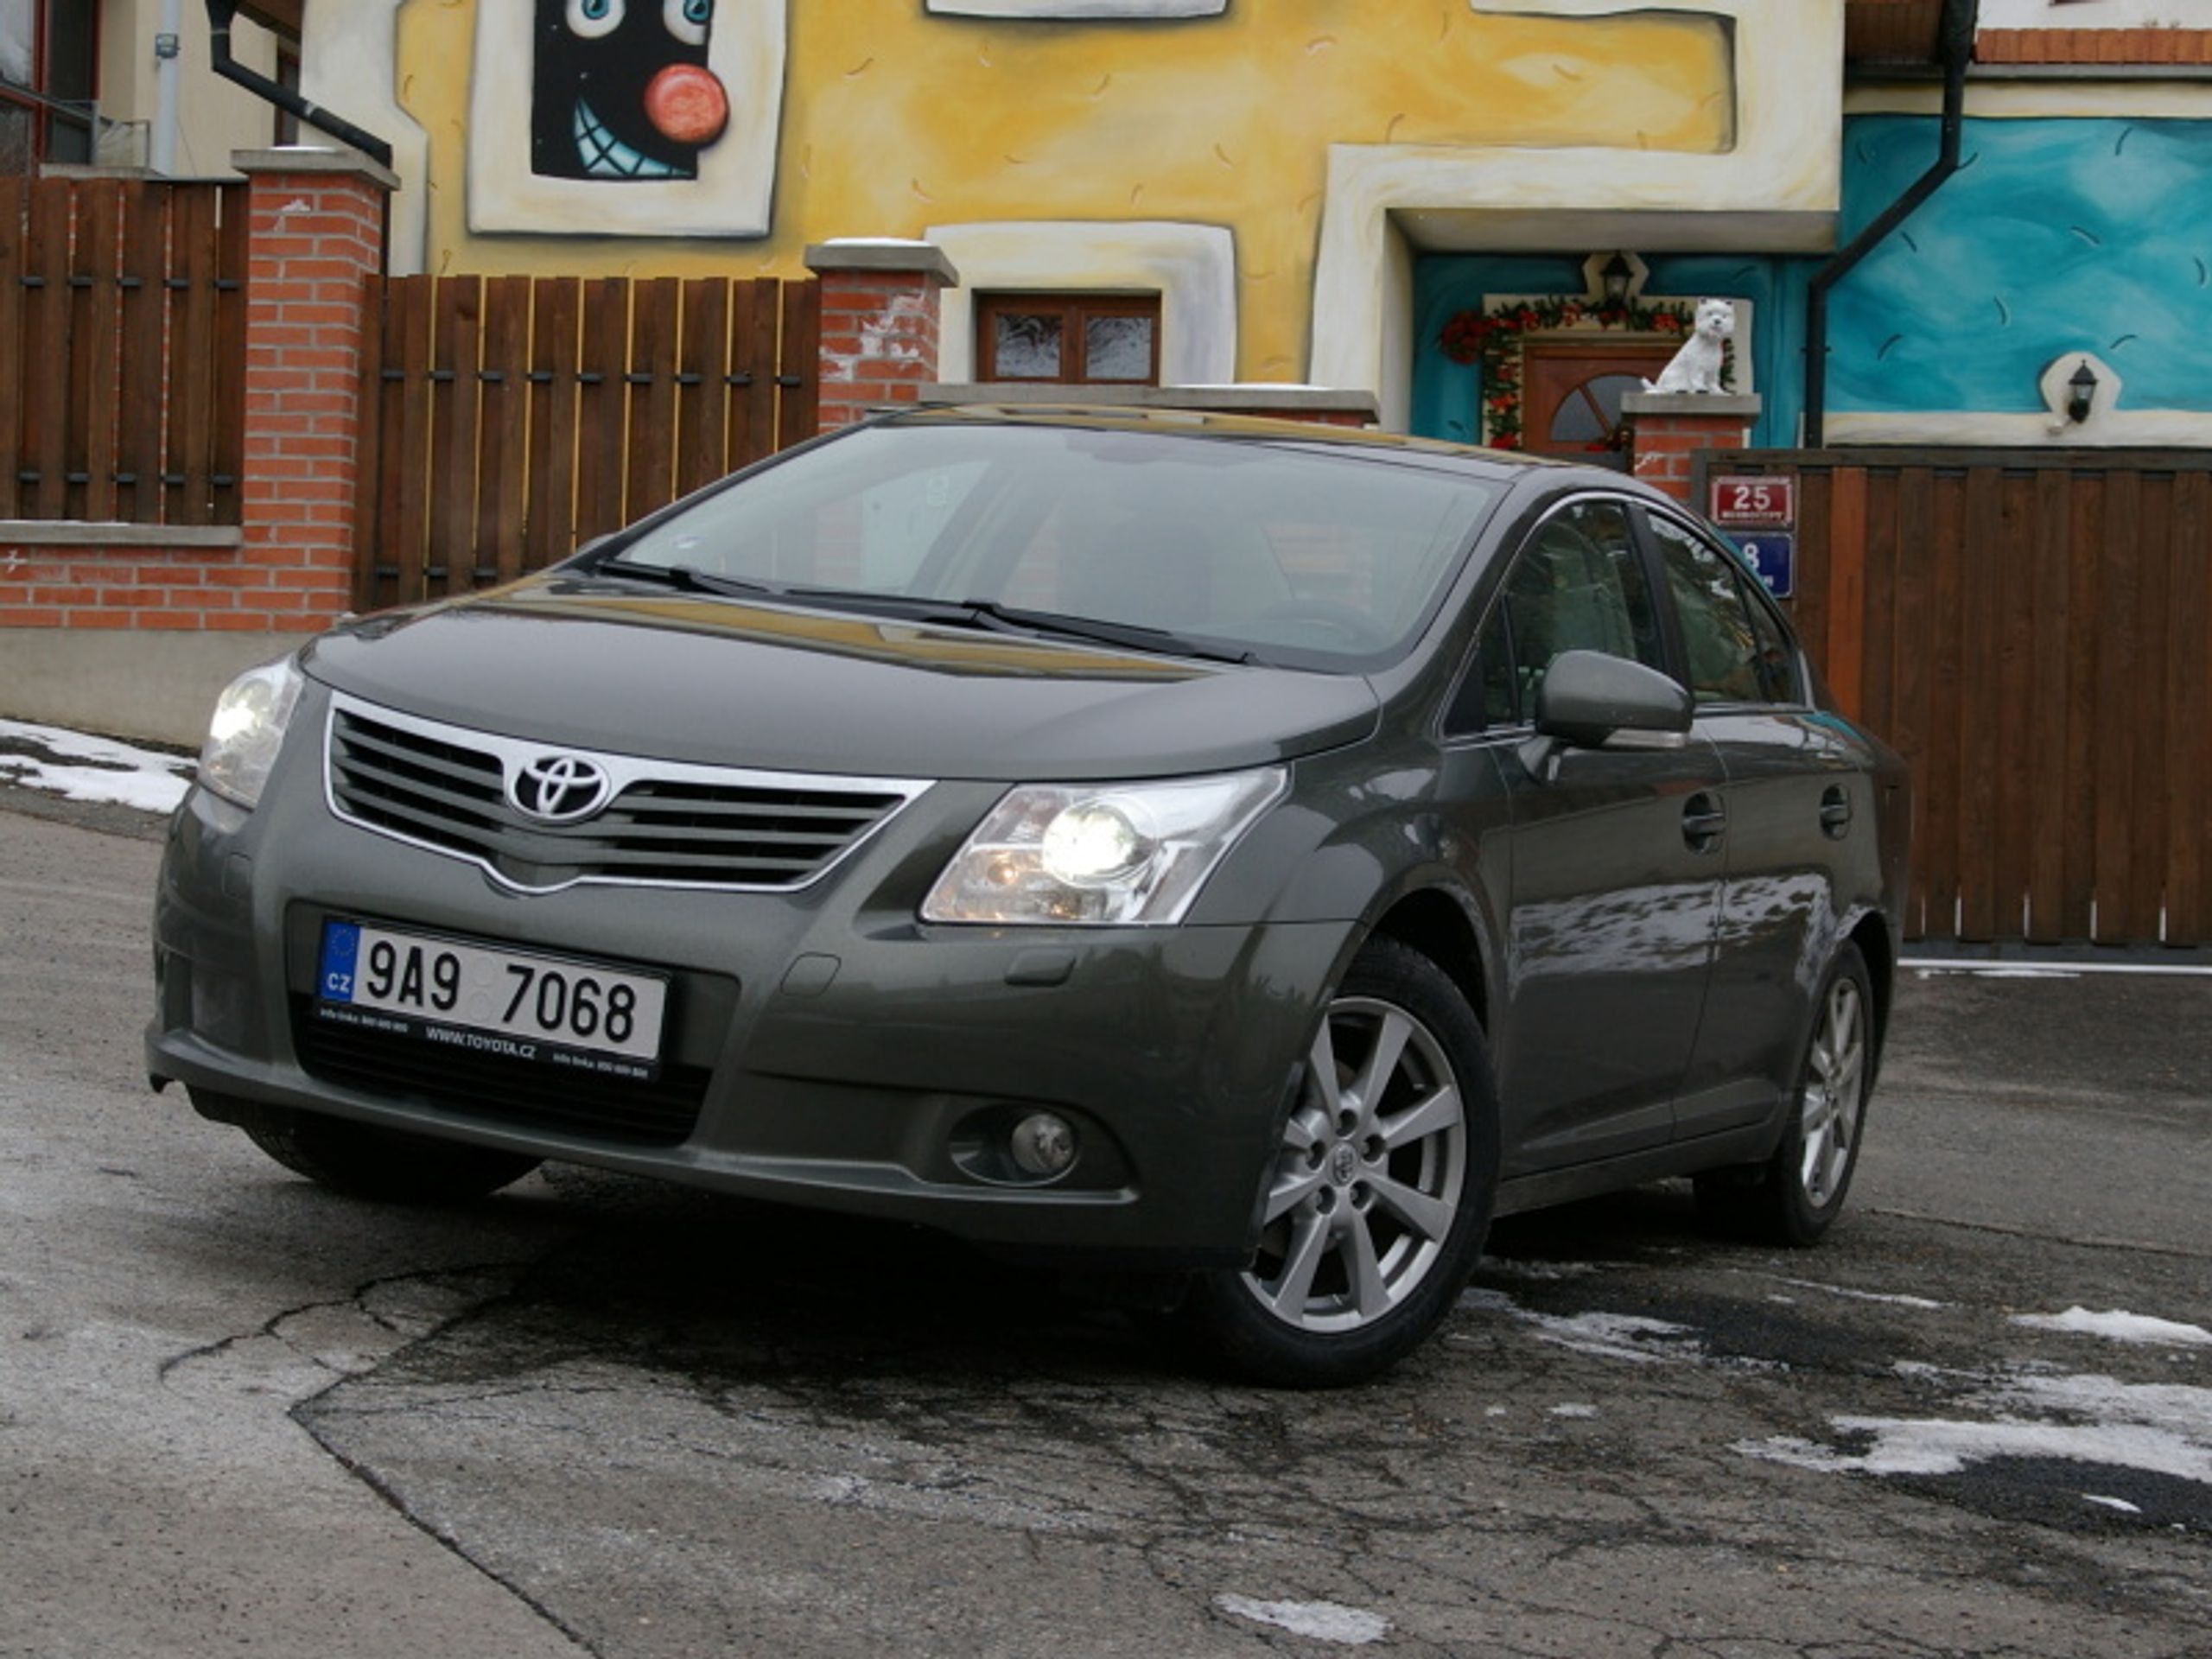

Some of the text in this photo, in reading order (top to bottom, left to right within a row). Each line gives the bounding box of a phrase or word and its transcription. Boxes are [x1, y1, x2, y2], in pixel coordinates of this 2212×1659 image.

[1733, 486, 1770, 511] 25
[327, 973, 352, 993] CZ
[367, 940, 636, 1043] 9A9 7068
[425, 1026, 536, 1060] WWW.TOYOTA.CZ
